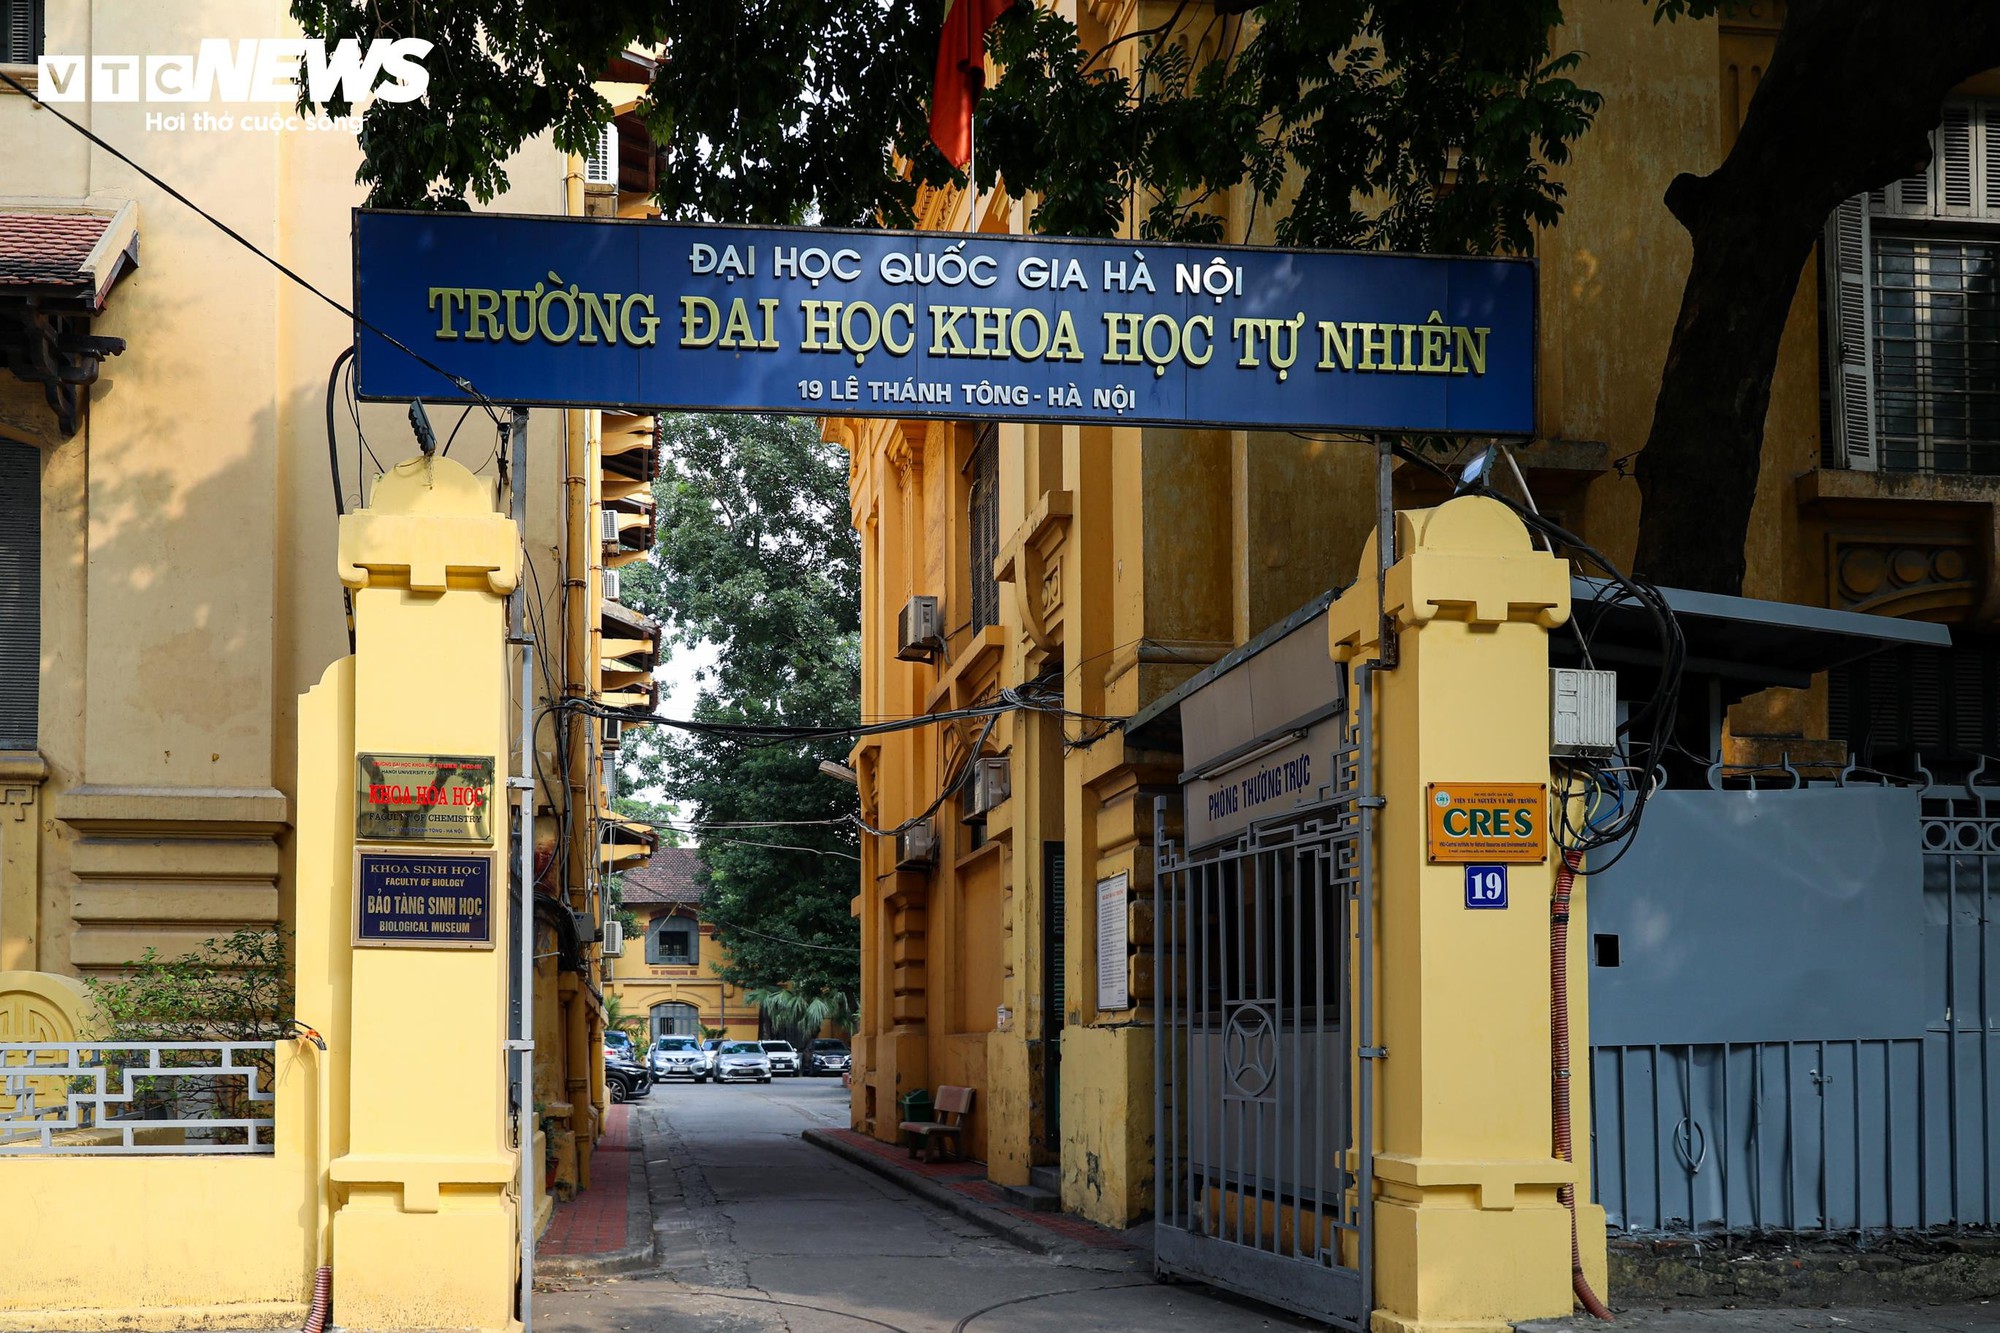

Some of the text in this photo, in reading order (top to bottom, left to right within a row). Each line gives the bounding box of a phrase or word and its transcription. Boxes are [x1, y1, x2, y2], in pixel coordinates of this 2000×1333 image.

[689, 239, 1244, 304] ĐẠI HỌC QUỐC GIA HÀ NỘI
[428, 270, 661, 348] TRƯỜNG
[800, 298, 915, 365] HỌC
[928, 303, 1084, 363] KHOA
[1102, 311, 1215, 377] HỌC
[1233, 311, 1306, 381] TỰ
[1317, 310, 1491, 376] NHIÊN
[798, 379, 823, 400] 19
[831, 375, 859, 401] LÊ
[868, 376, 952, 404] THÁNH
[961, 380, 1029, 406] TÔNG
[1048, 382, 1083, 408] HÀ
[1093, 384, 1136, 414] NỘI
[369, 780, 484, 811] KHOA HÓA HỌC
[1208, 753, 1311, 821] PHÒNG THƯỜNG TRỰC
[369, 813, 482, 823] FACULTY OF CHEMISTRY
[1443, 808, 1533, 838] CRES
[370, 864, 481, 877] KHOA SINH HỌC
[385, 877, 465, 887] FACULTY OF BIOLOGY
[1471, 872, 1502, 900] 19
[367, 887, 482, 920] BẢO TÀNG SINH HỌC
[379, 920, 470, 933] BIOLOGICAL MUSEUM
